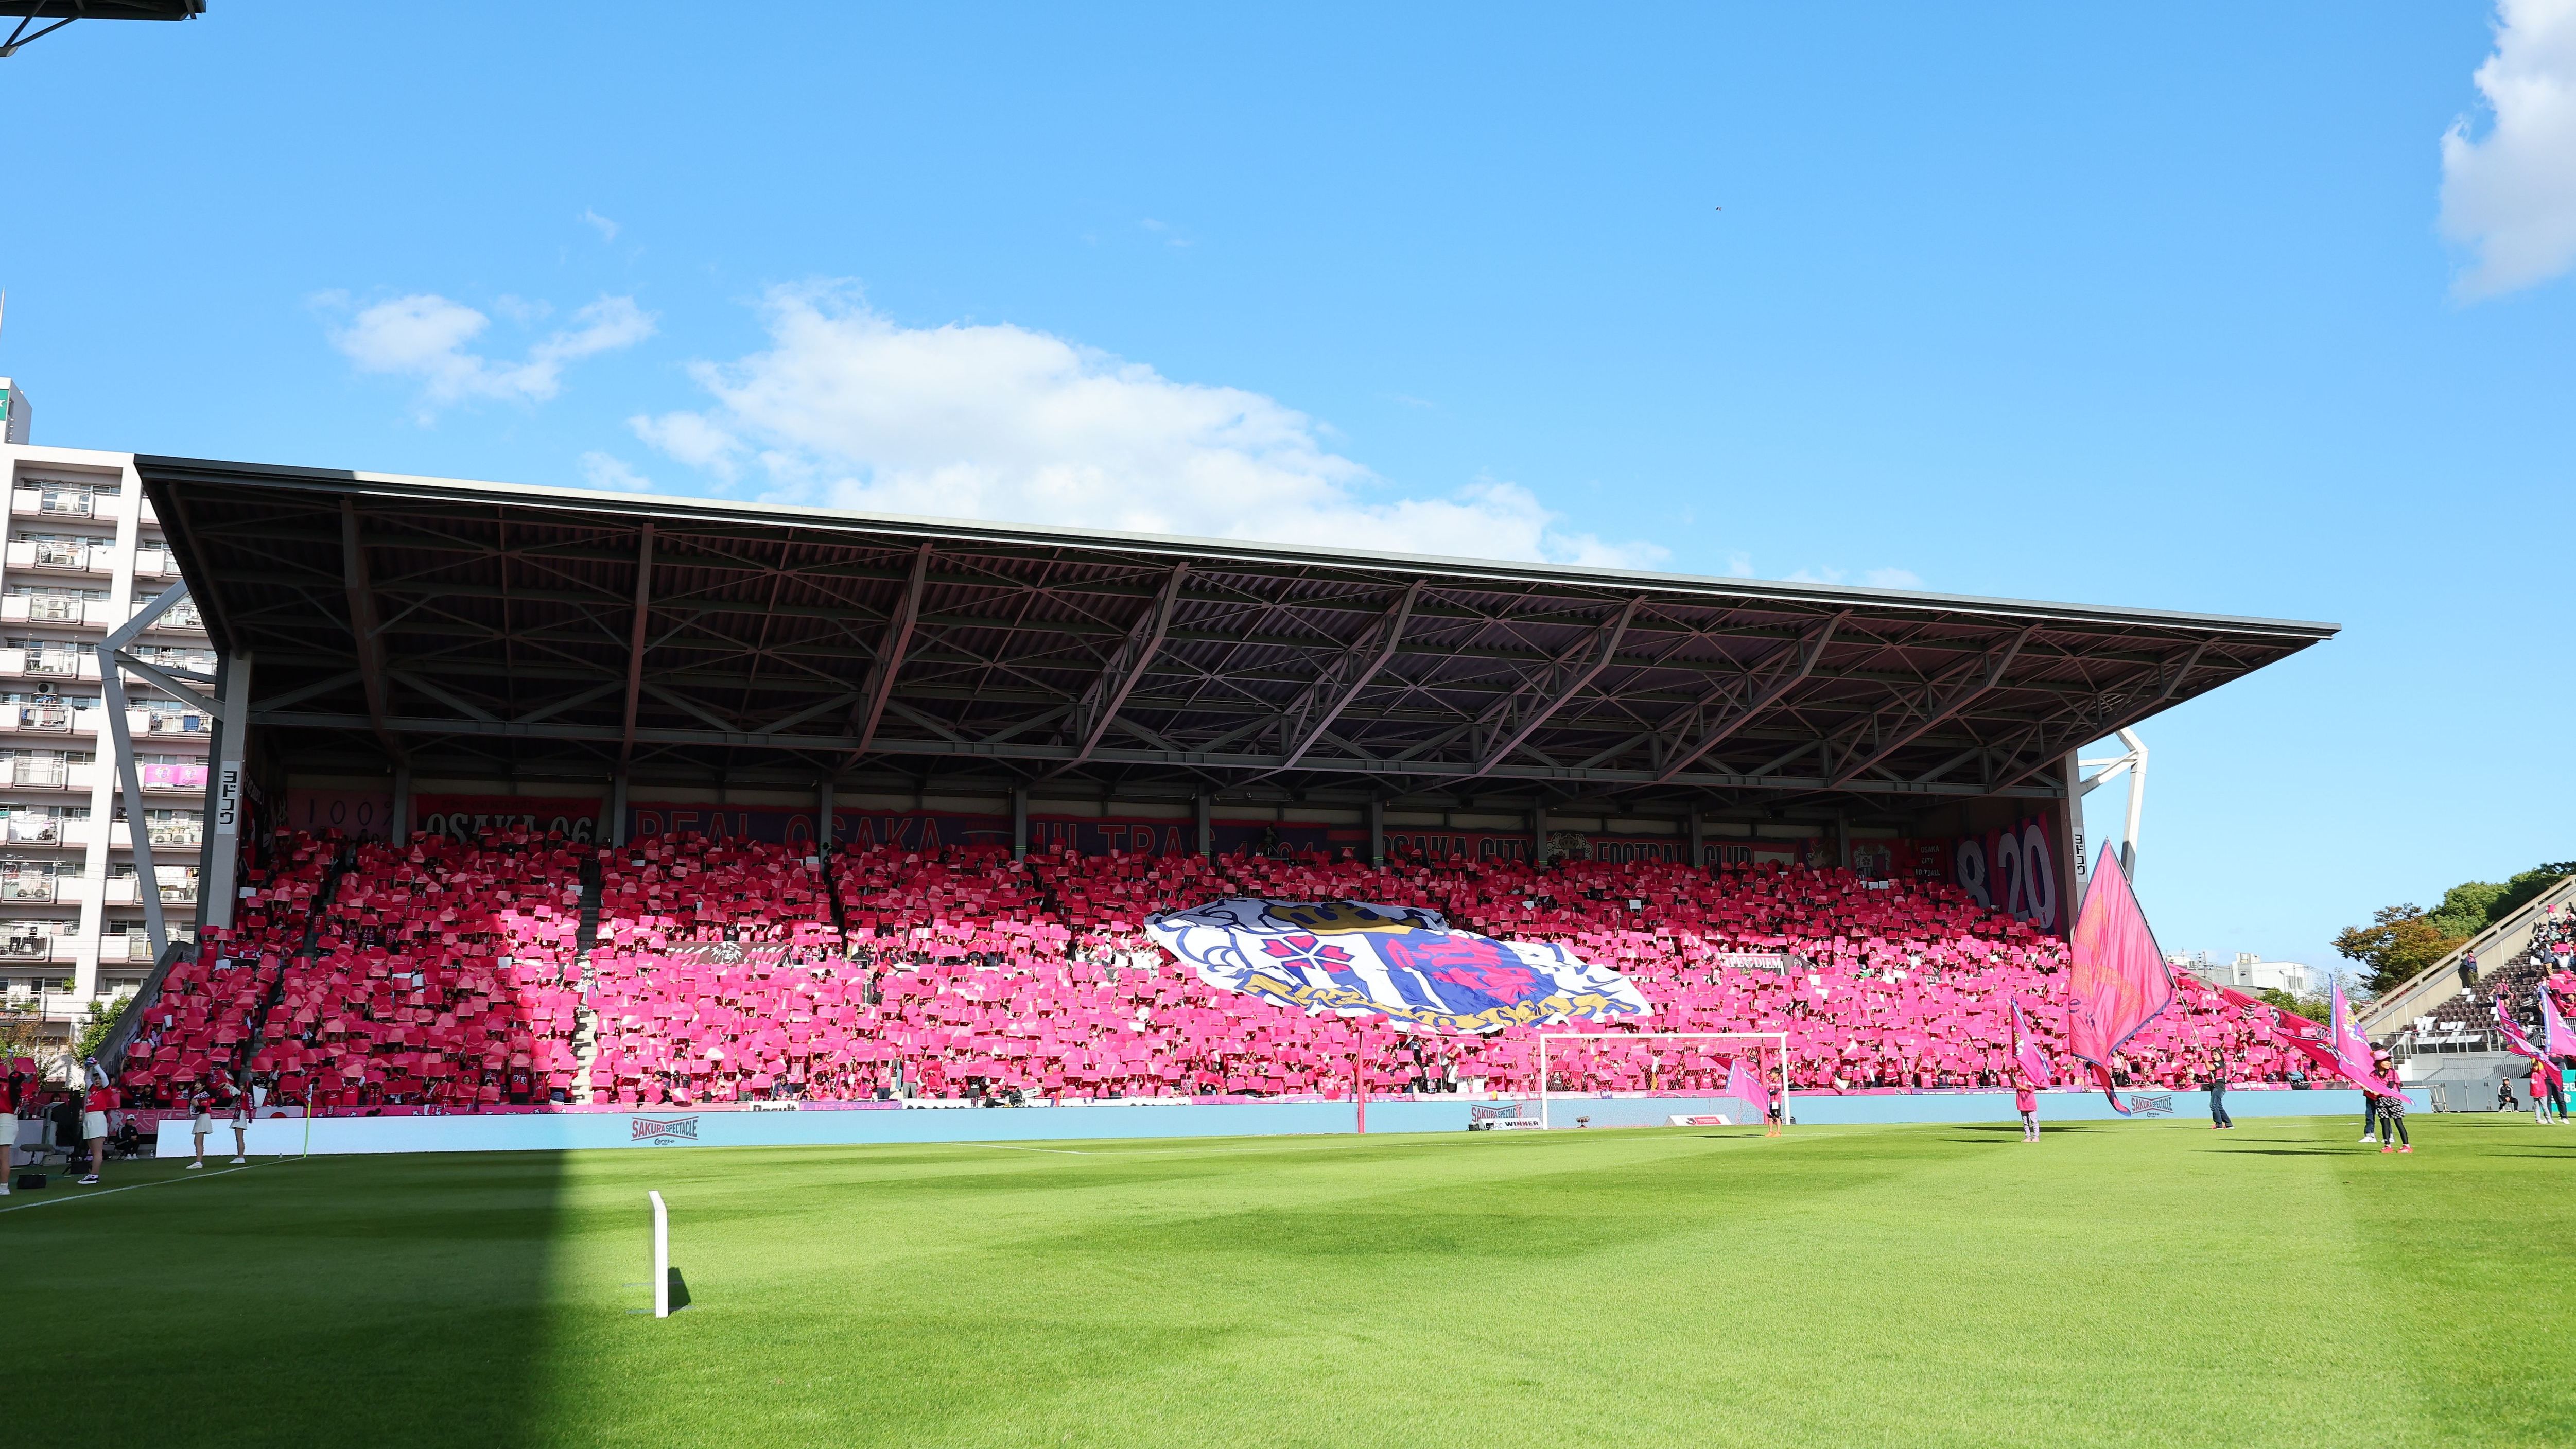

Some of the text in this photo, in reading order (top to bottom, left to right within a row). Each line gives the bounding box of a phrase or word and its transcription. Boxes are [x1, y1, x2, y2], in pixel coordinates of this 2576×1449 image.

[220, 770, 237, 824] ヨドコウ
[1597, 841, 1694, 863] FOOTBA
[1920, 844, 1940, 853] OSAKA
[2075, 834, 2085, 875] ヨドコウ
[1916, 868, 1941, 877] FOTBALL
[1998, 824, 2056, 929] 20
[1755, 957, 1781, 969] DIEM
[2131, 1096, 2173, 1112] SAKURA SPECTACLE
[1471, 1107, 1498, 1122] SAKURA
[632, 1119, 698, 1138] SAKURA SPECTACLE
